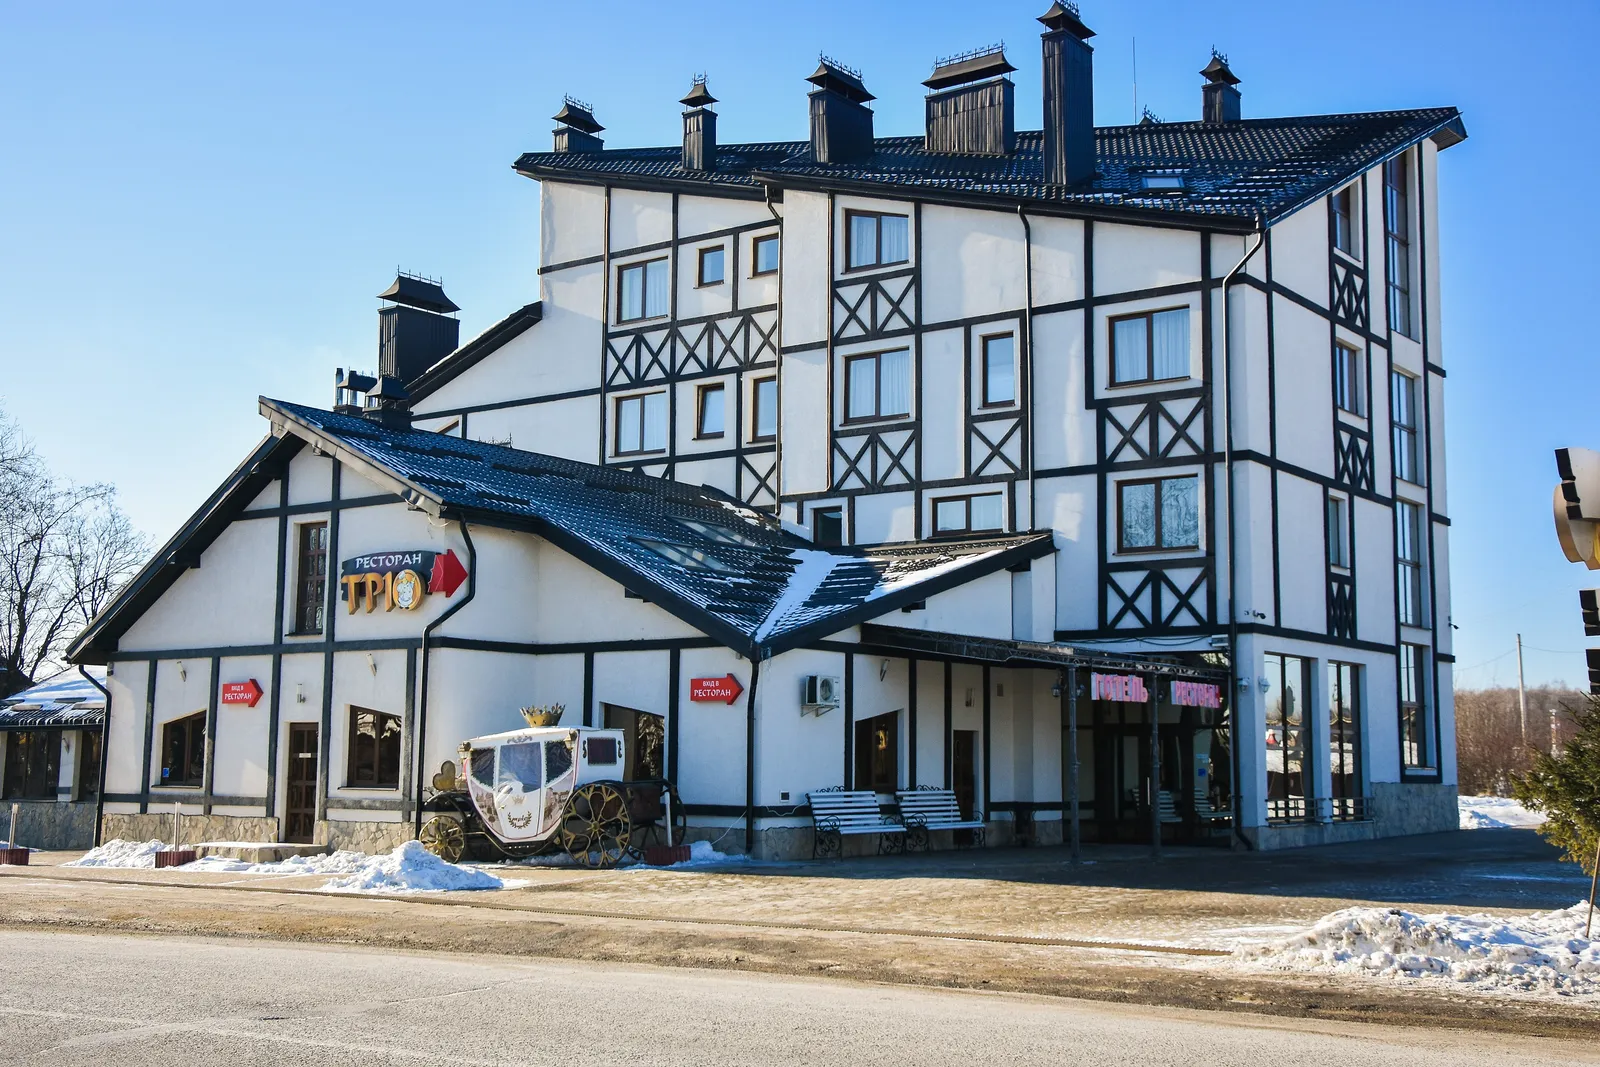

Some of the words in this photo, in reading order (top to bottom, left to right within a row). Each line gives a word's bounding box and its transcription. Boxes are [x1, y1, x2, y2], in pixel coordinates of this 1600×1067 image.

[355, 553, 422, 569] РЕСТОРАН
[702, 680, 715, 688] ВХІД
[1091, 671, 1149, 703] ГОТЕЛЬ
[224, 692, 252, 700] РЕСТОРАН
[693, 689, 731, 697] РЕСТОРАН
[1170, 681, 1221, 709] РЕСТОРАН
